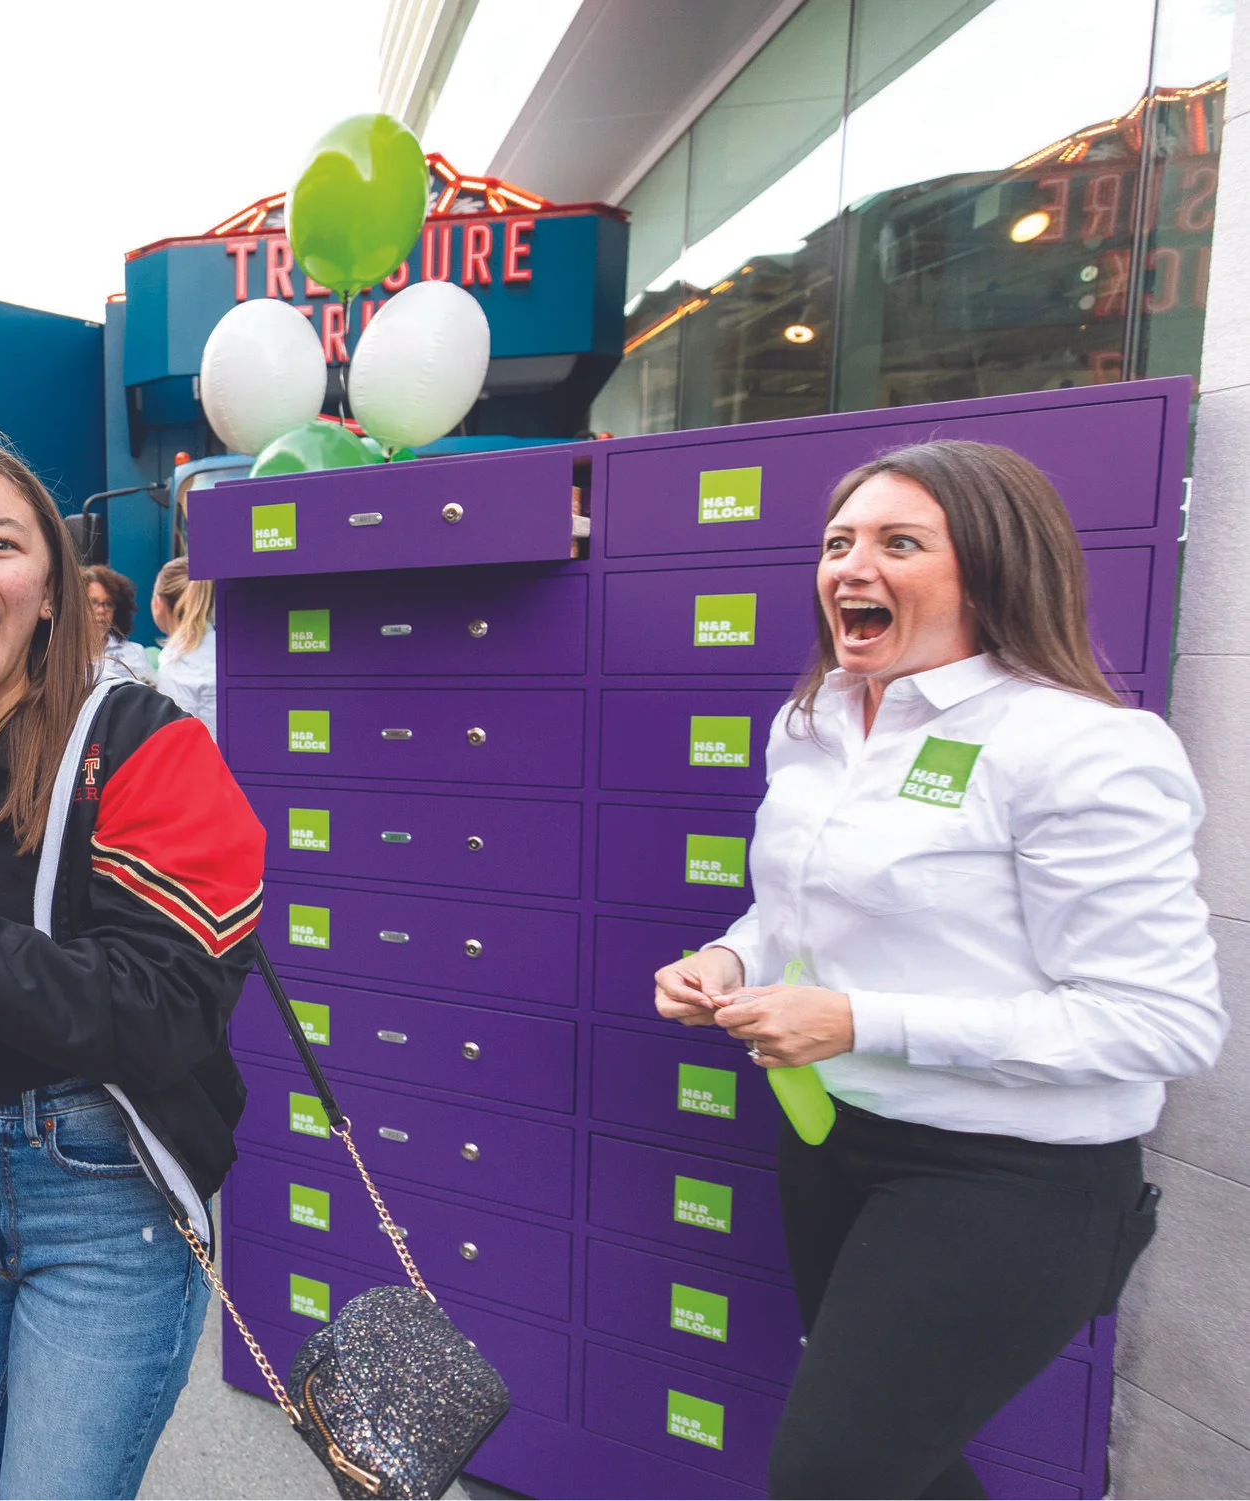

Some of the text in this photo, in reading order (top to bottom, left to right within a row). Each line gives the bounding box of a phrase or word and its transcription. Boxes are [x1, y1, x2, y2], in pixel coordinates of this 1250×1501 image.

[226, 218, 535, 301] TRURE
[702, 495, 737, 509] H&R
[702, 505, 756, 521] BLOCK
[254, 527, 279, 539] H&R
[255, 536, 293, 549] BLOCK
[697, 619, 732, 632] H&R
[291, 631, 314, 641] H&R
[697, 631, 750, 643] BLOCK
[291, 640, 327, 650] BLOCK
[291, 731, 315, 742] H&R
[291, 739, 327, 750] BLOCK
[693, 741, 727, 753] H&R
[693, 751, 745, 764] BLOCK
[910, 768, 953, 788] H&R
[904, 783, 965, 804] BLOCK
[291, 829, 315, 840] H&R
[291, 836, 327, 849] BLOCK
[689, 859, 722, 872] H&R
[689, 869, 739, 884] BLOCK
[291, 924, 315, 936] H&R
[291, 932, 327, 947] BLOCK
[298, 1021, 314, 1032] &R
[681, 1087, 713, 1102] H&R
[681, 1097, 730, 1115] BLOCK
[292, 1119, 327, 1136] BLOCK
[677, 1199, 709, 1215] H&R
[292, 1210, 327, 1228] BLOCK
[677, 1209, 726, 1229] BLOCK
[293, 1300, 327, 1319] BLOCK
[674, 1306, 705, 1323] H&R
[673, 1316, 722, 1338] BLOCK
[671, 1413, 701, 1431] H&R
[670, 1421, 718, 1446] BLOCK
